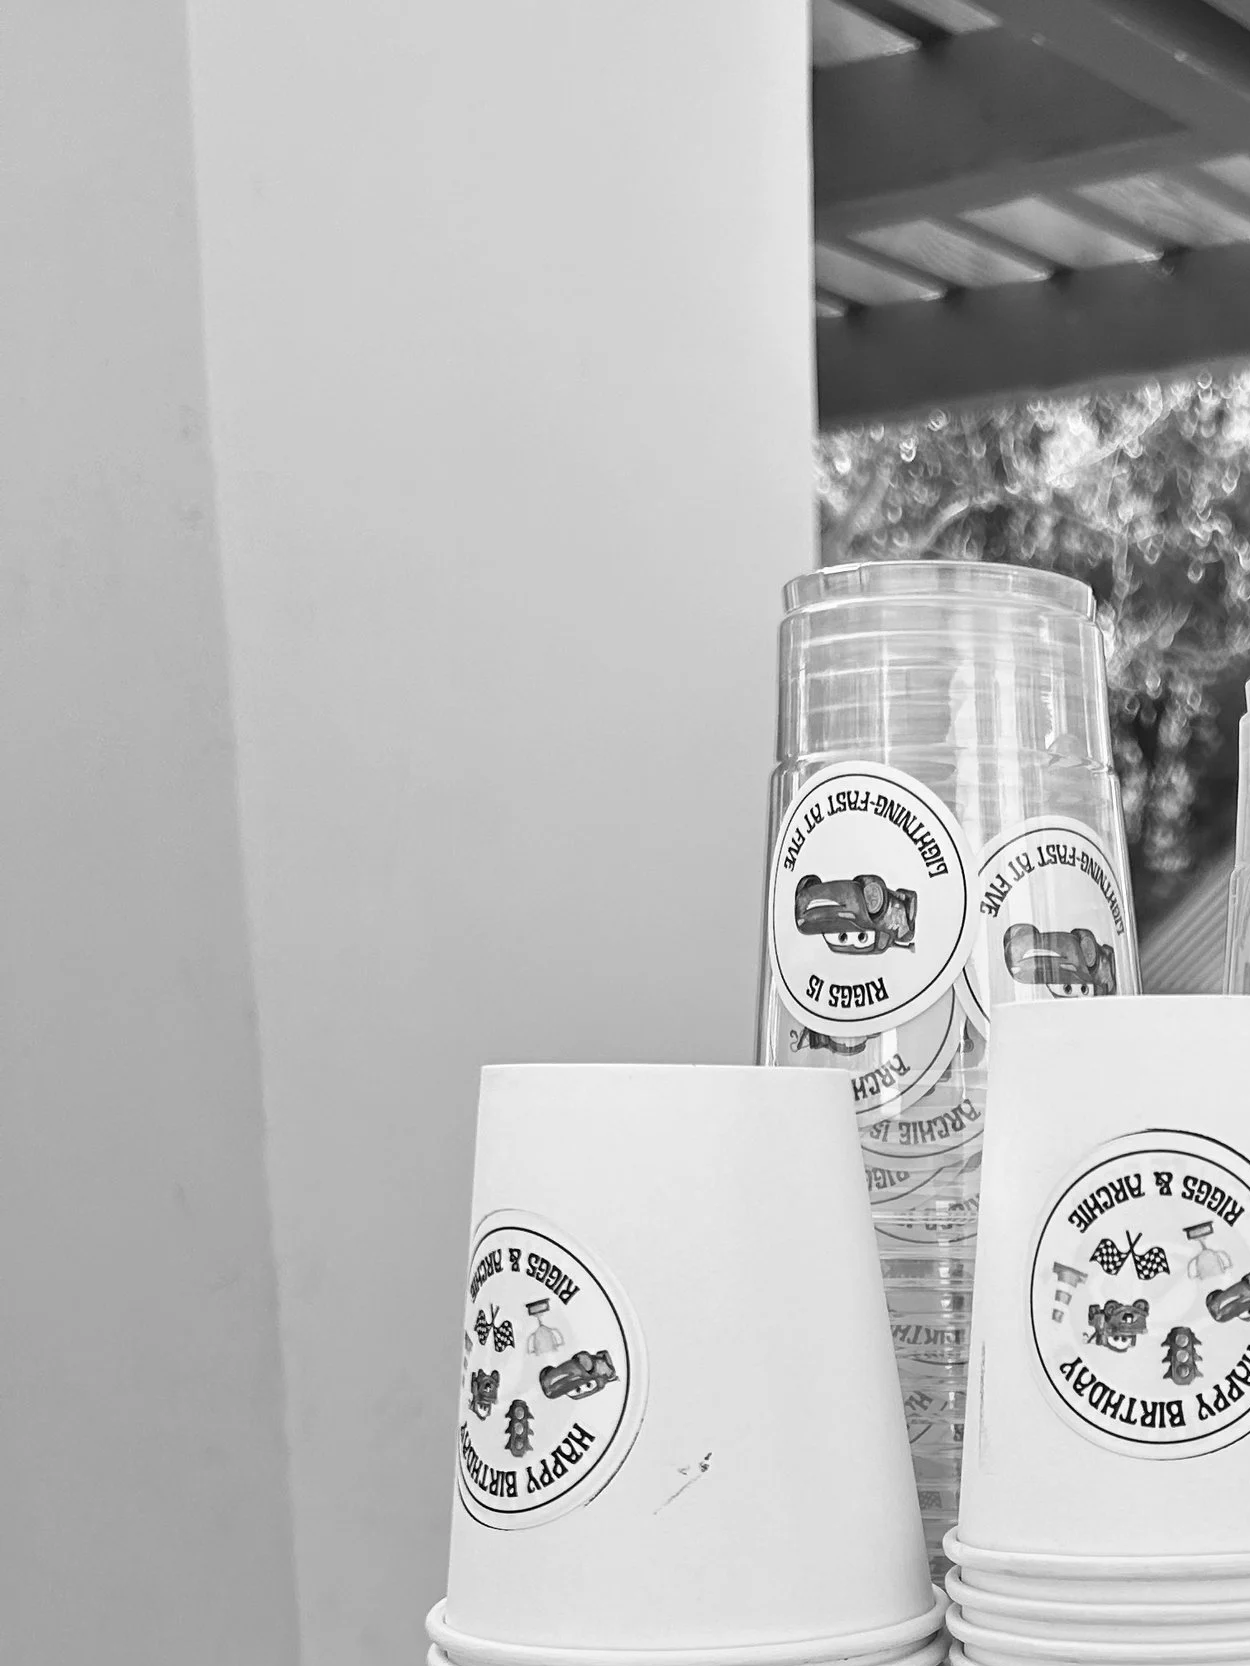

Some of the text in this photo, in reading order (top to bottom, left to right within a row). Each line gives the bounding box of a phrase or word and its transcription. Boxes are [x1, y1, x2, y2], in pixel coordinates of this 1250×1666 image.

[783, 790, 949, 878] LIGHTNING-FAST AT FIVE
[1009, 853, 1033, 885] AT
[979, 876, 1008, 918] FIVE
[805, 974, 889, 1008] RIGGS IS
[852, 1052, 911, 1101] ARCH
[870, 1099, 982, 1145] ARCHIE IS
[1068, 1171, 1245, 1234] RIGGS & ARCHIE
[509, 1248, 522, 1271] &
[526, 1253, 580, 1305] RIGGS
[1059, 1357, 1187, 1429] BIRTHDAY
[460, 1421, 596, 1498] HAPPY BIRTHDAY
